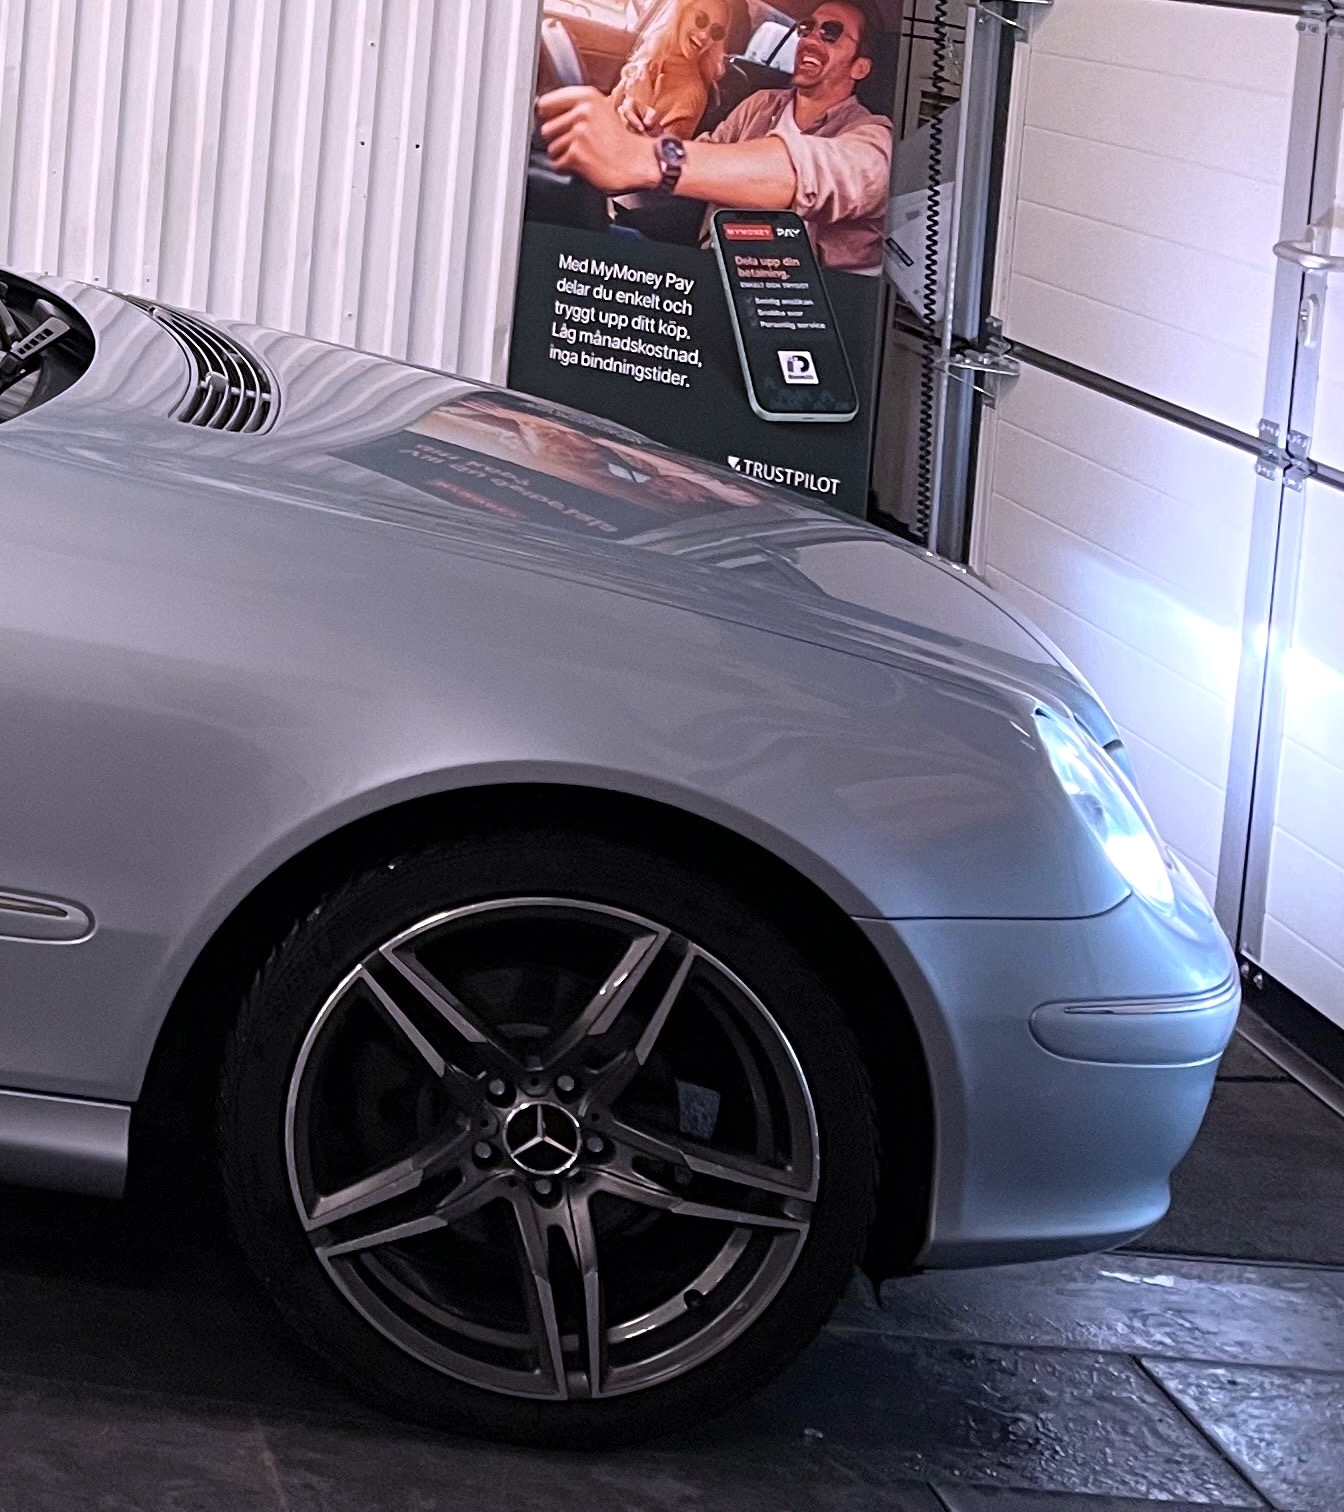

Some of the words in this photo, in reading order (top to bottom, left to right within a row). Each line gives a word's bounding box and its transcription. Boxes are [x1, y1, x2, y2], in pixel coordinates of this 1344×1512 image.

[558, 253, 590, 274] Med
[590, 259, 664, 290] MyMoney
[665, 273, 695, 295] Pay
[556, 277, 591, 297] delar
[592, 283, 613, 301] du
[615, 290, 661, 311] enkelt
[662, 299, 693, 316] och
[554, 299, 596, 324] tryggt
[598, 310, 629, 330] upp
[631, 314, 656, 333] ditt
[658, 319, 691, 341] köp.
[549, 343, 579, 366] inga
[580, 351, 690, 388] bindningstider.
[551, 321, 577, 345] Låg
[578, 329, 703, 368] månadskostnad,
[743, 459, 841, 496] TRUSTPILOT
